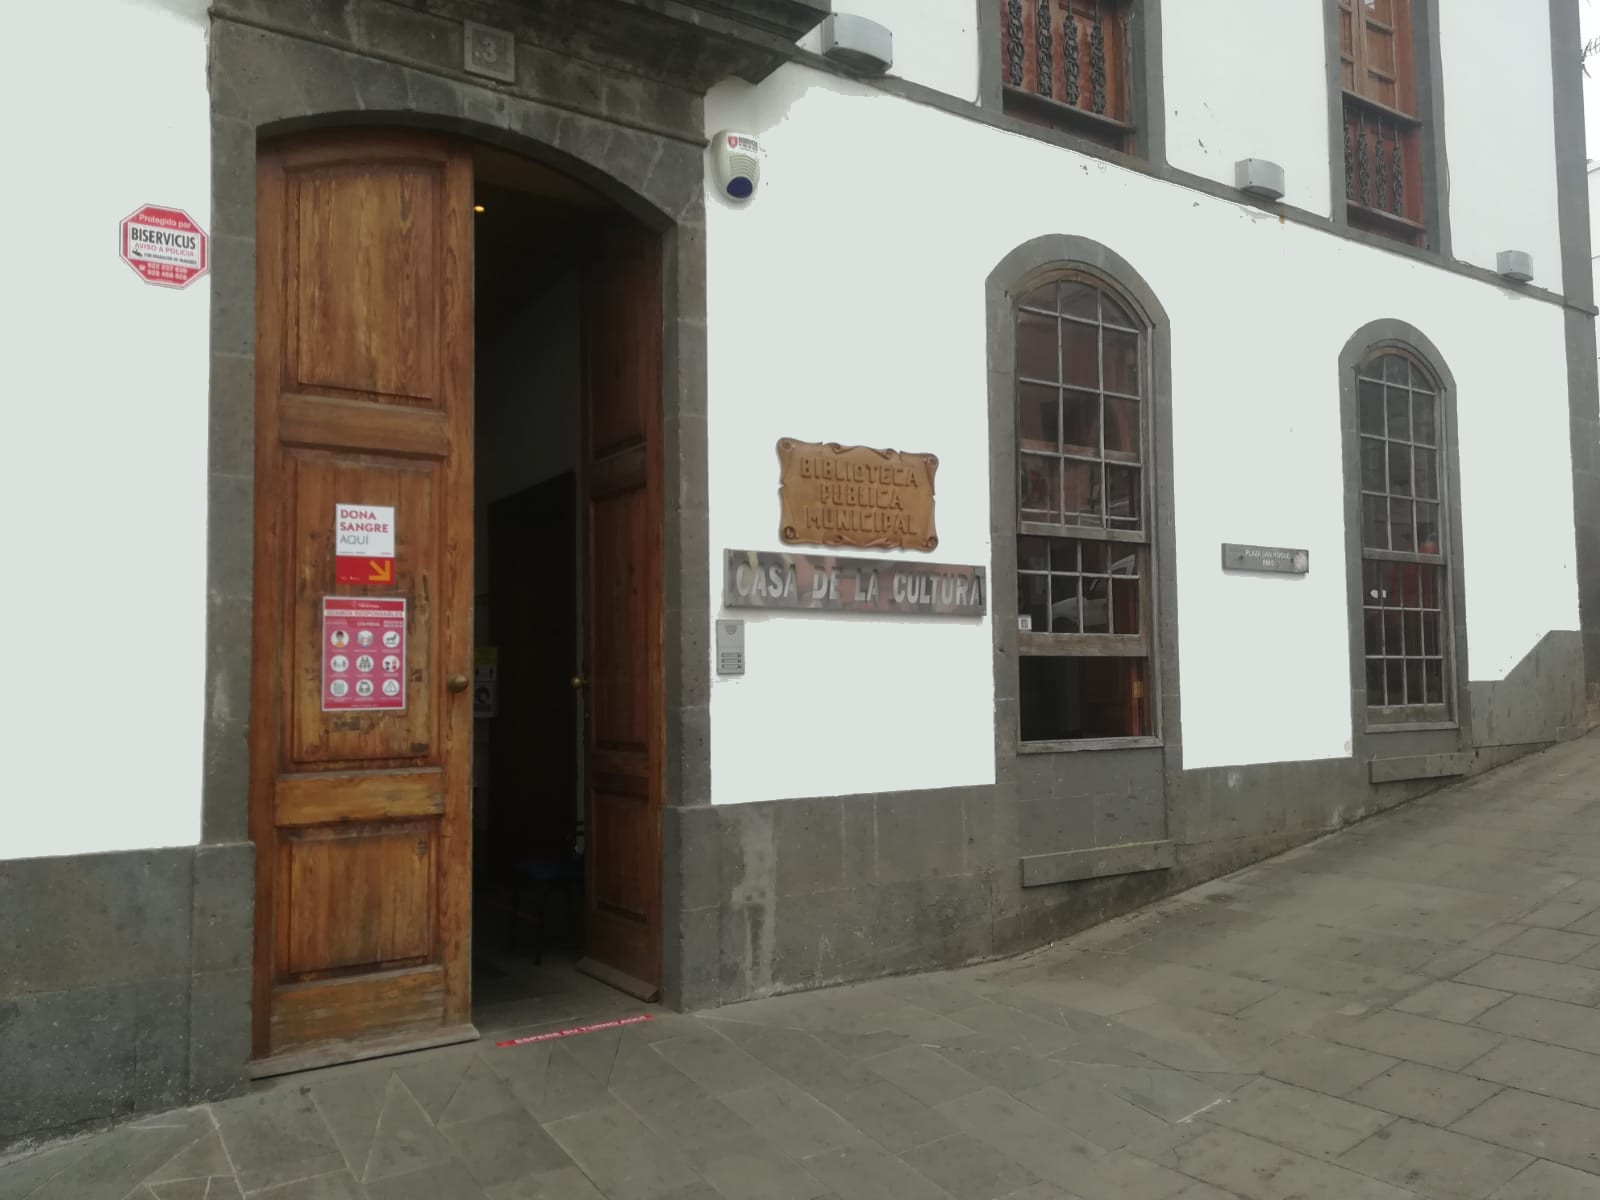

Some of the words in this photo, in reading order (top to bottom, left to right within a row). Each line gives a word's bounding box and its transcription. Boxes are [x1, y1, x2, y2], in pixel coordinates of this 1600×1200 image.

[139, 213, 176, 226] Protegido
[178, 221, 191, 229] por
[131, 227, 196, 250] BISERVICUS
[134, 242, 157, 253] AVISO
[159, 245, 165, 253] A
[801, 456, 918, 487] BIBLIOTECA
[821, 484, 904, 510] PUBLICA
[340, 509, 377, 521] DONA
[806, 508, 917, 534] MUNICIPAL
[340, 521, 390, 534] SANGRE
[736, 563, 799, 600] CASA
[812, 567, 841, 600] DE
[854, 568, 880, 604] LA
[893, 573, 982, 606] CULTURA
